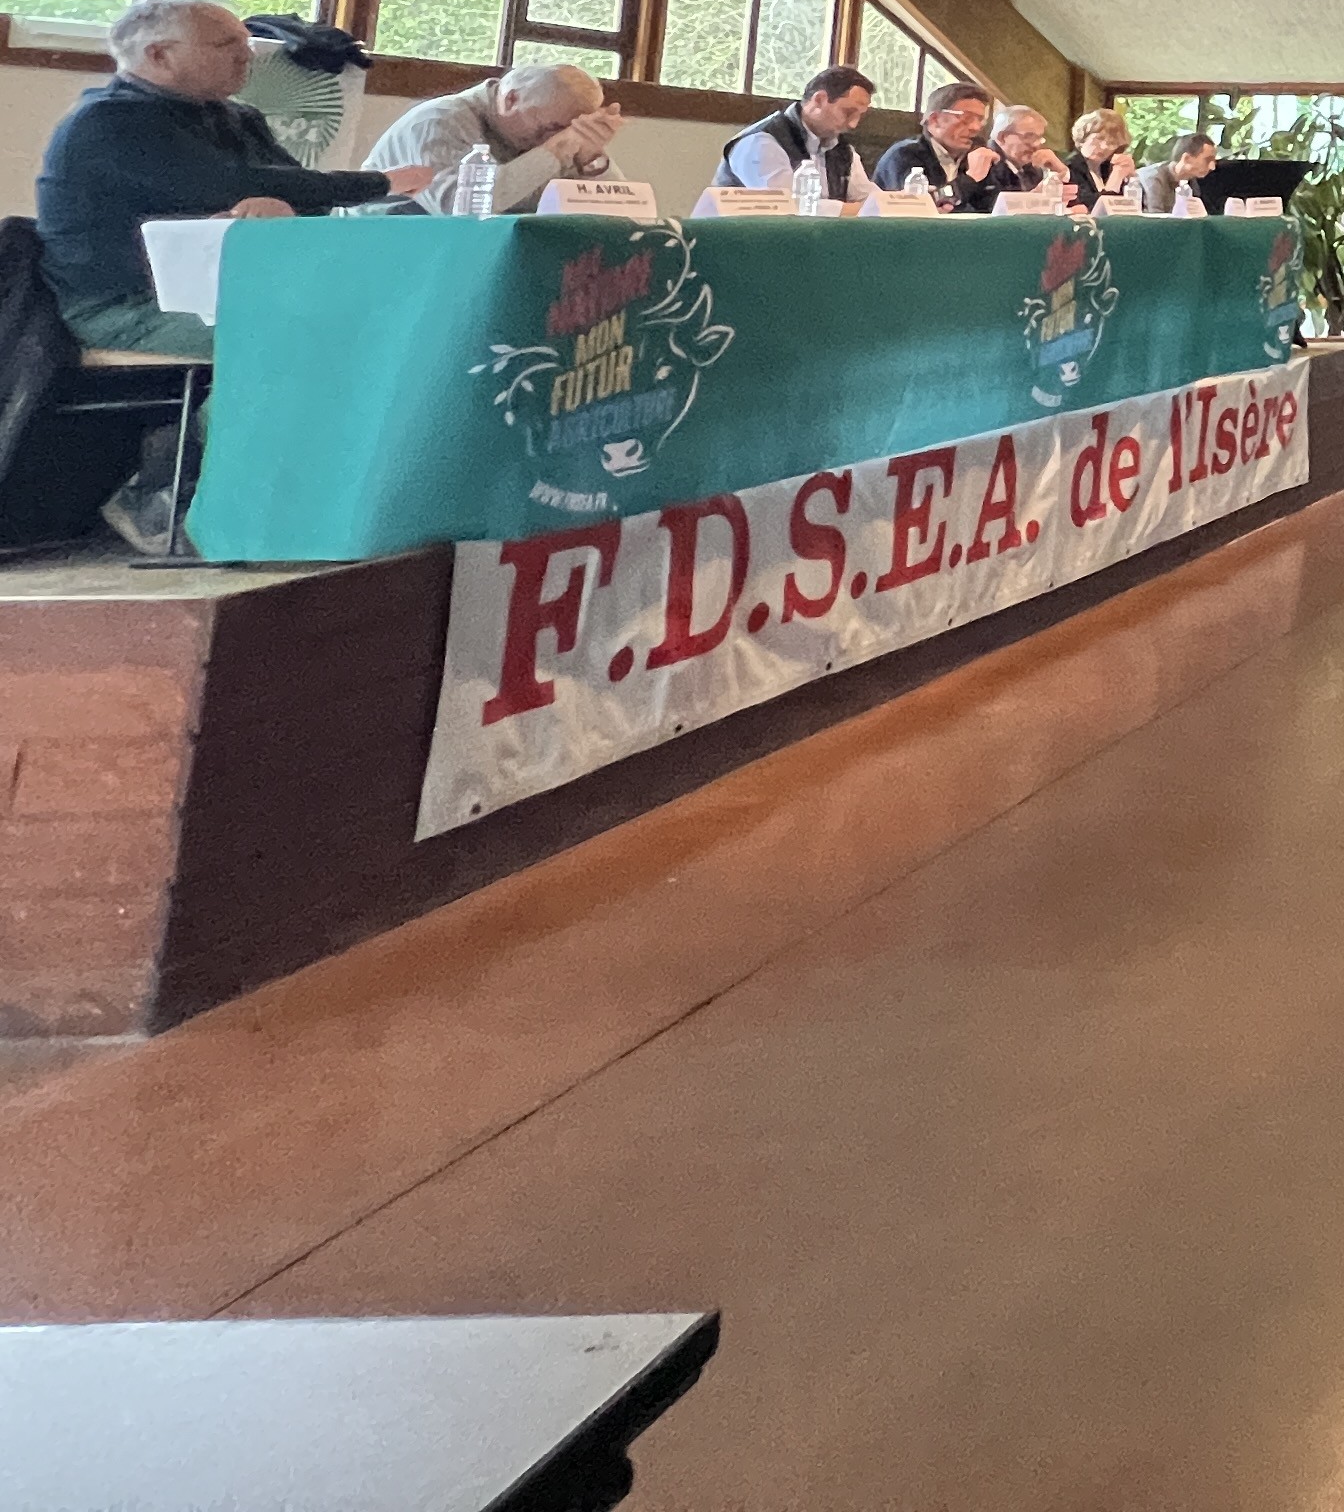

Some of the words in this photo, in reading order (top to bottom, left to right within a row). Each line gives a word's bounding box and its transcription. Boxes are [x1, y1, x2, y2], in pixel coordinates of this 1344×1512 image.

[551, 345, 634, 417] FUTUR
[482, 434, 1040, 726] F.D.S.E.A.
[1070, 411, 1141, 528] de
[1168, 380, 1298, 495] l'Isère
